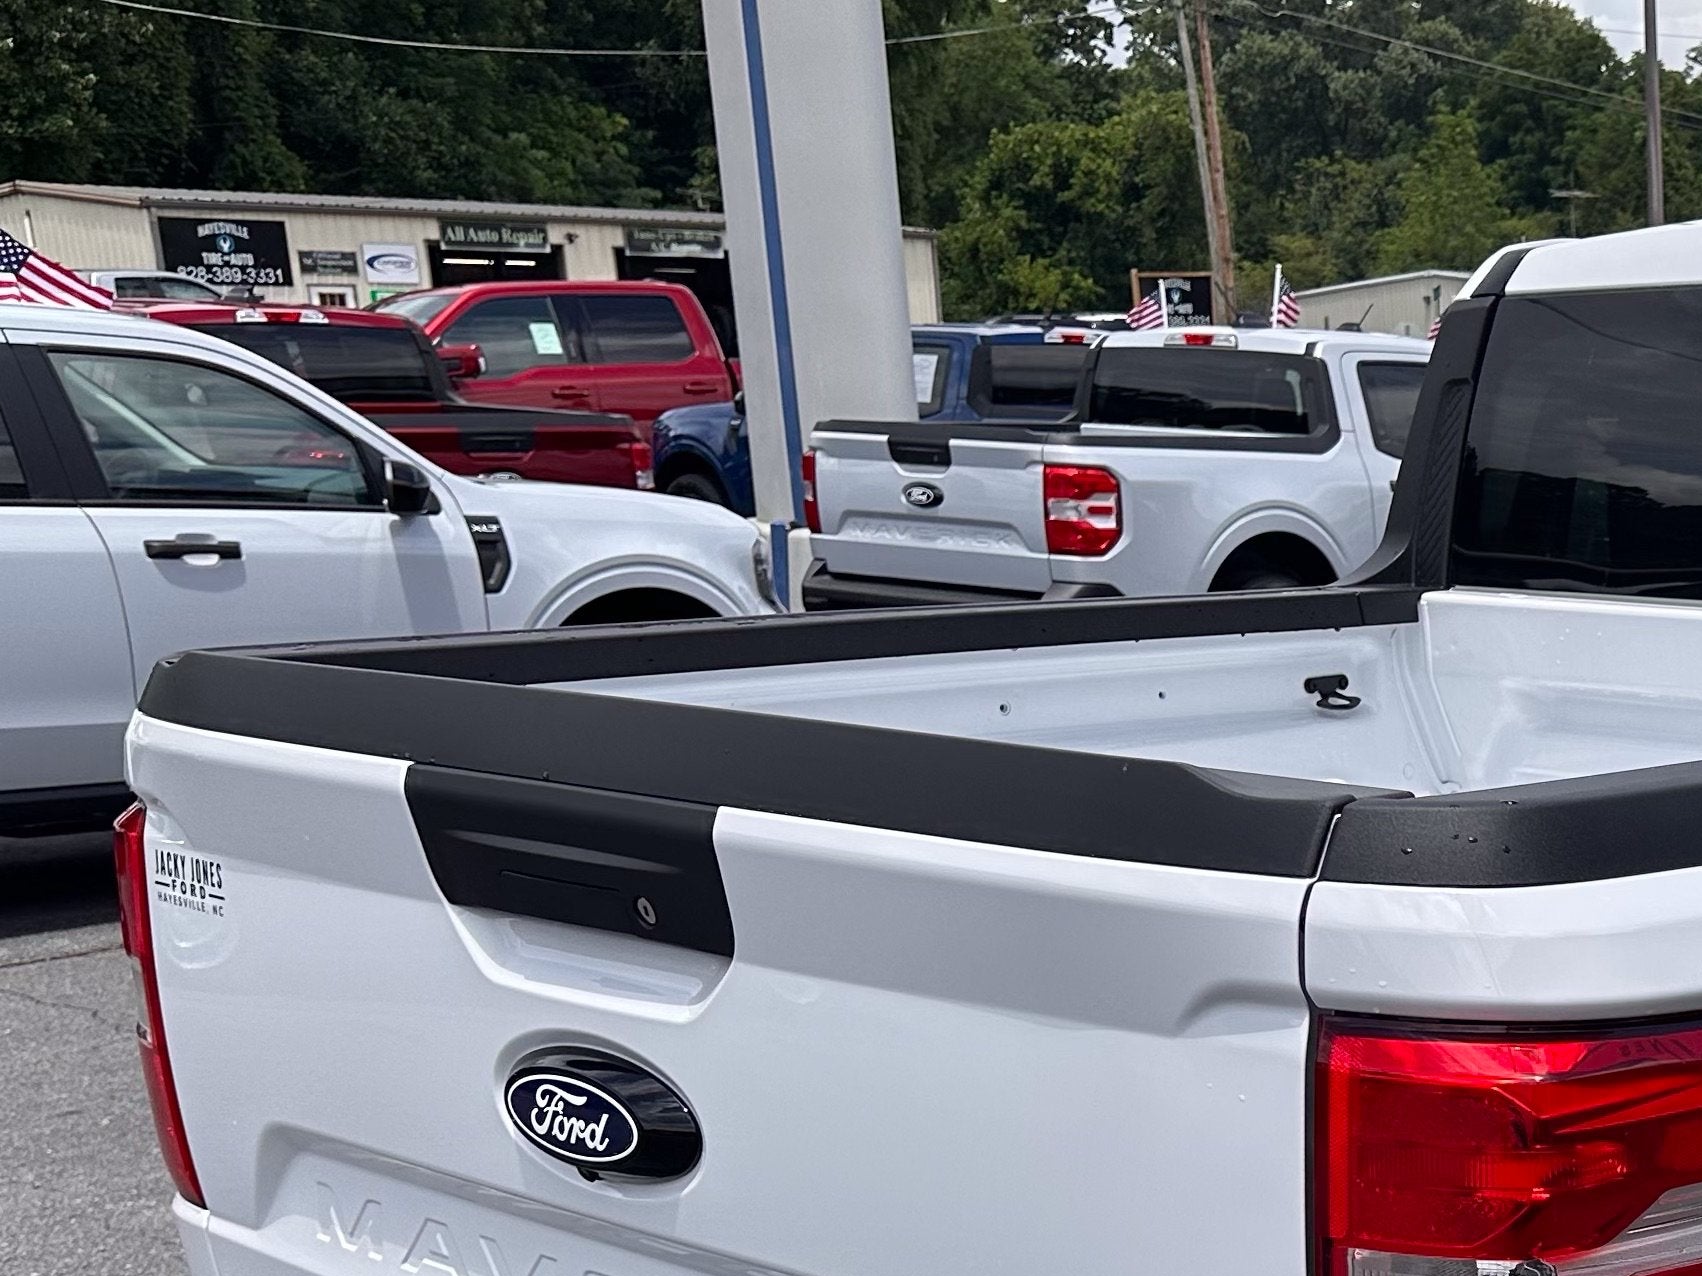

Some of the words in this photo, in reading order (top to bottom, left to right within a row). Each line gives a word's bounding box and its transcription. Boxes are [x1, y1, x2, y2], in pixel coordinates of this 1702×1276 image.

[445, 226, 465, 241] All
[467, 227, 499, 242] Auto
[501, 227, 545, 246] Repair
[155, 849, 185, 880] JACKY
[191, 857, 222, 889] JONES
[171, 879, 206, 899] FORD
[212, 905, 224, 917] NC
[530, 1083, 610, 1152] Ford
